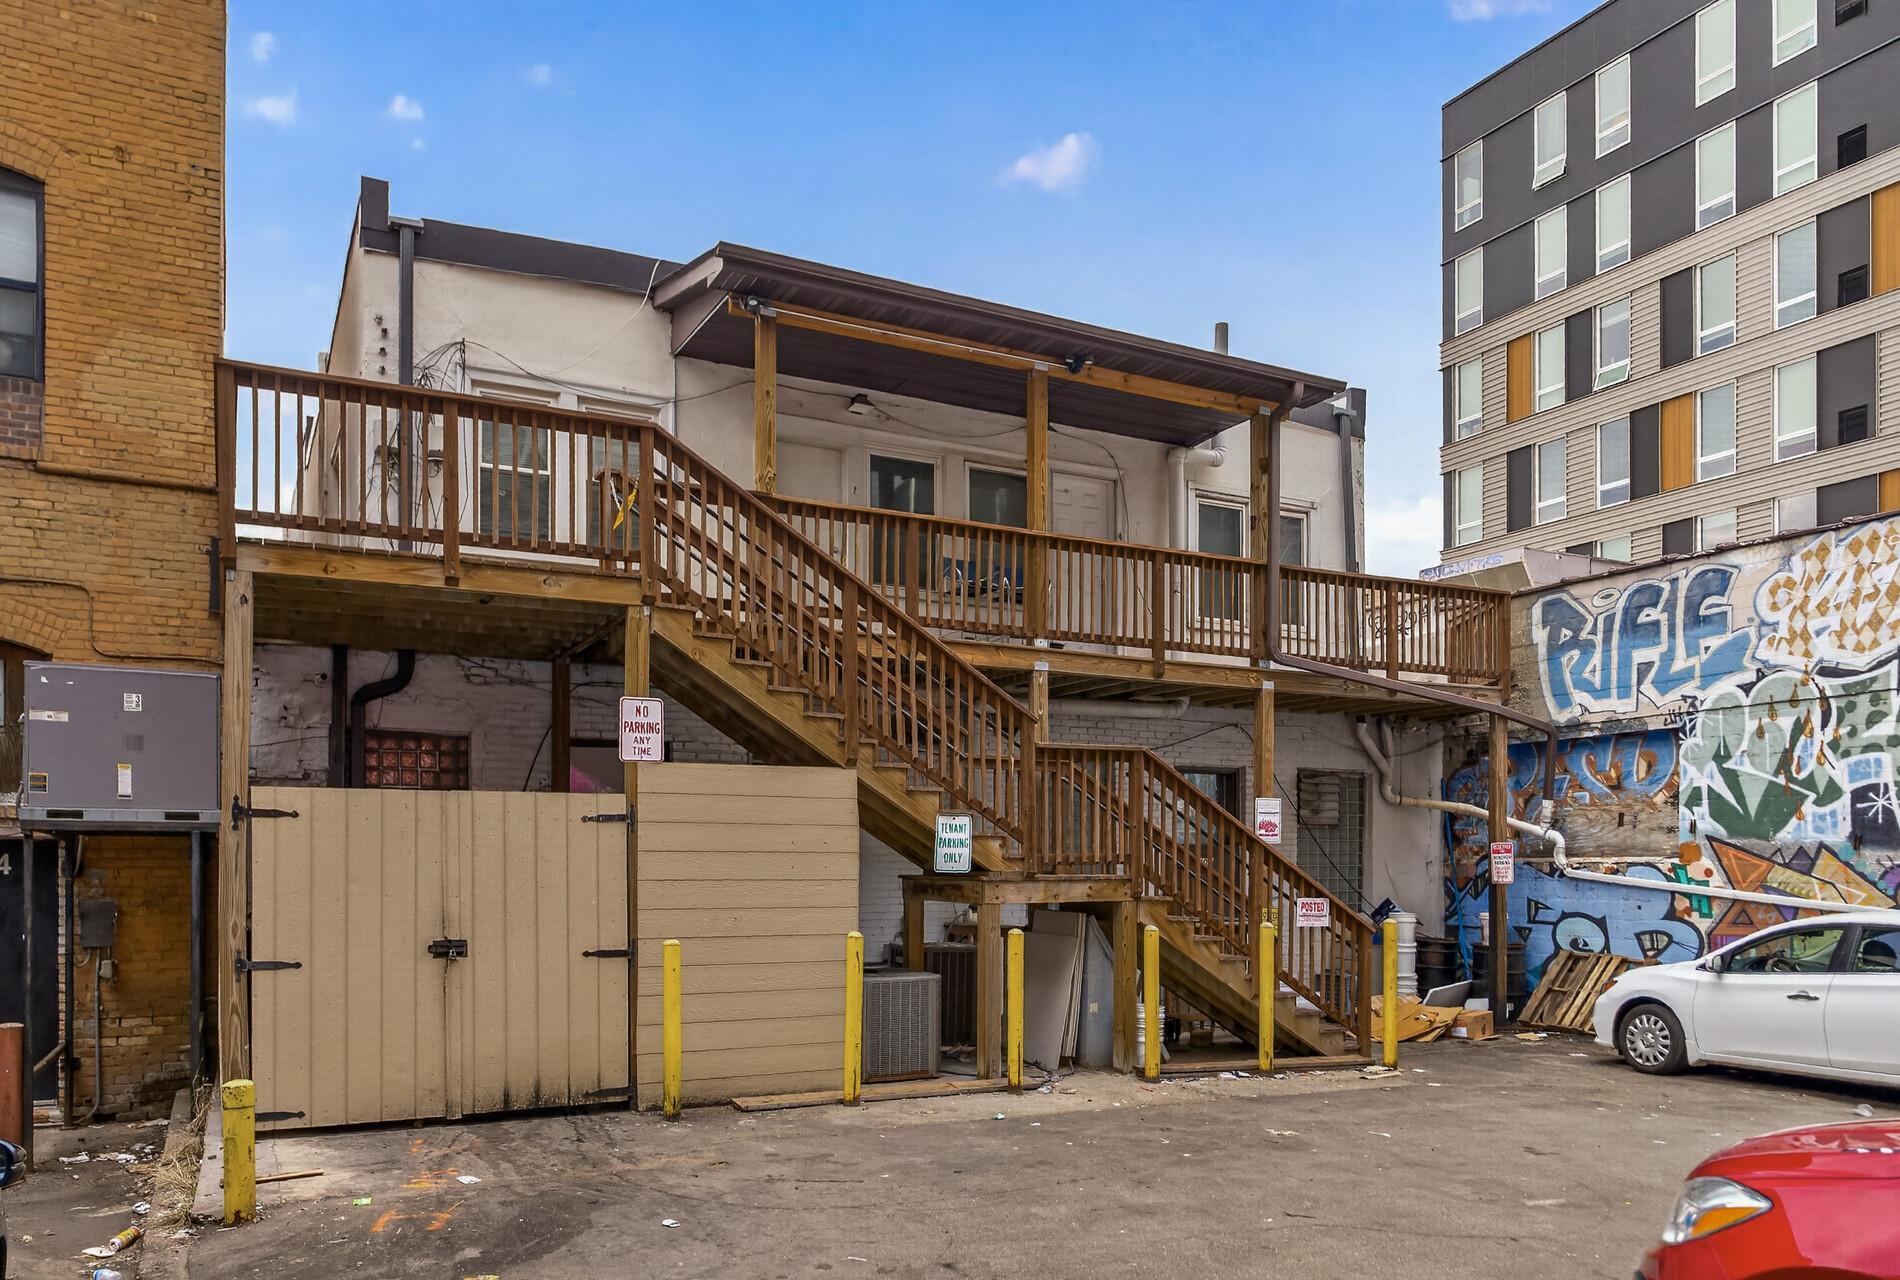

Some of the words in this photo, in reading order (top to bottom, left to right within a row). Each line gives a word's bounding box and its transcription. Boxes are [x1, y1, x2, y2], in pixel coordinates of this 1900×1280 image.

[635, 705, 649, 718] NO
[623, 720, 661, 735] PARKING
[632, 736, 651, 745] ANY
[632, 746, 652, 756] TIME
[941, 822, 967, 834] TENANT
[938, 836, 969, 849] PARKING
[943, 852, 963, 864] ONLY
[1300, 901, 1325, 913] POSTED
